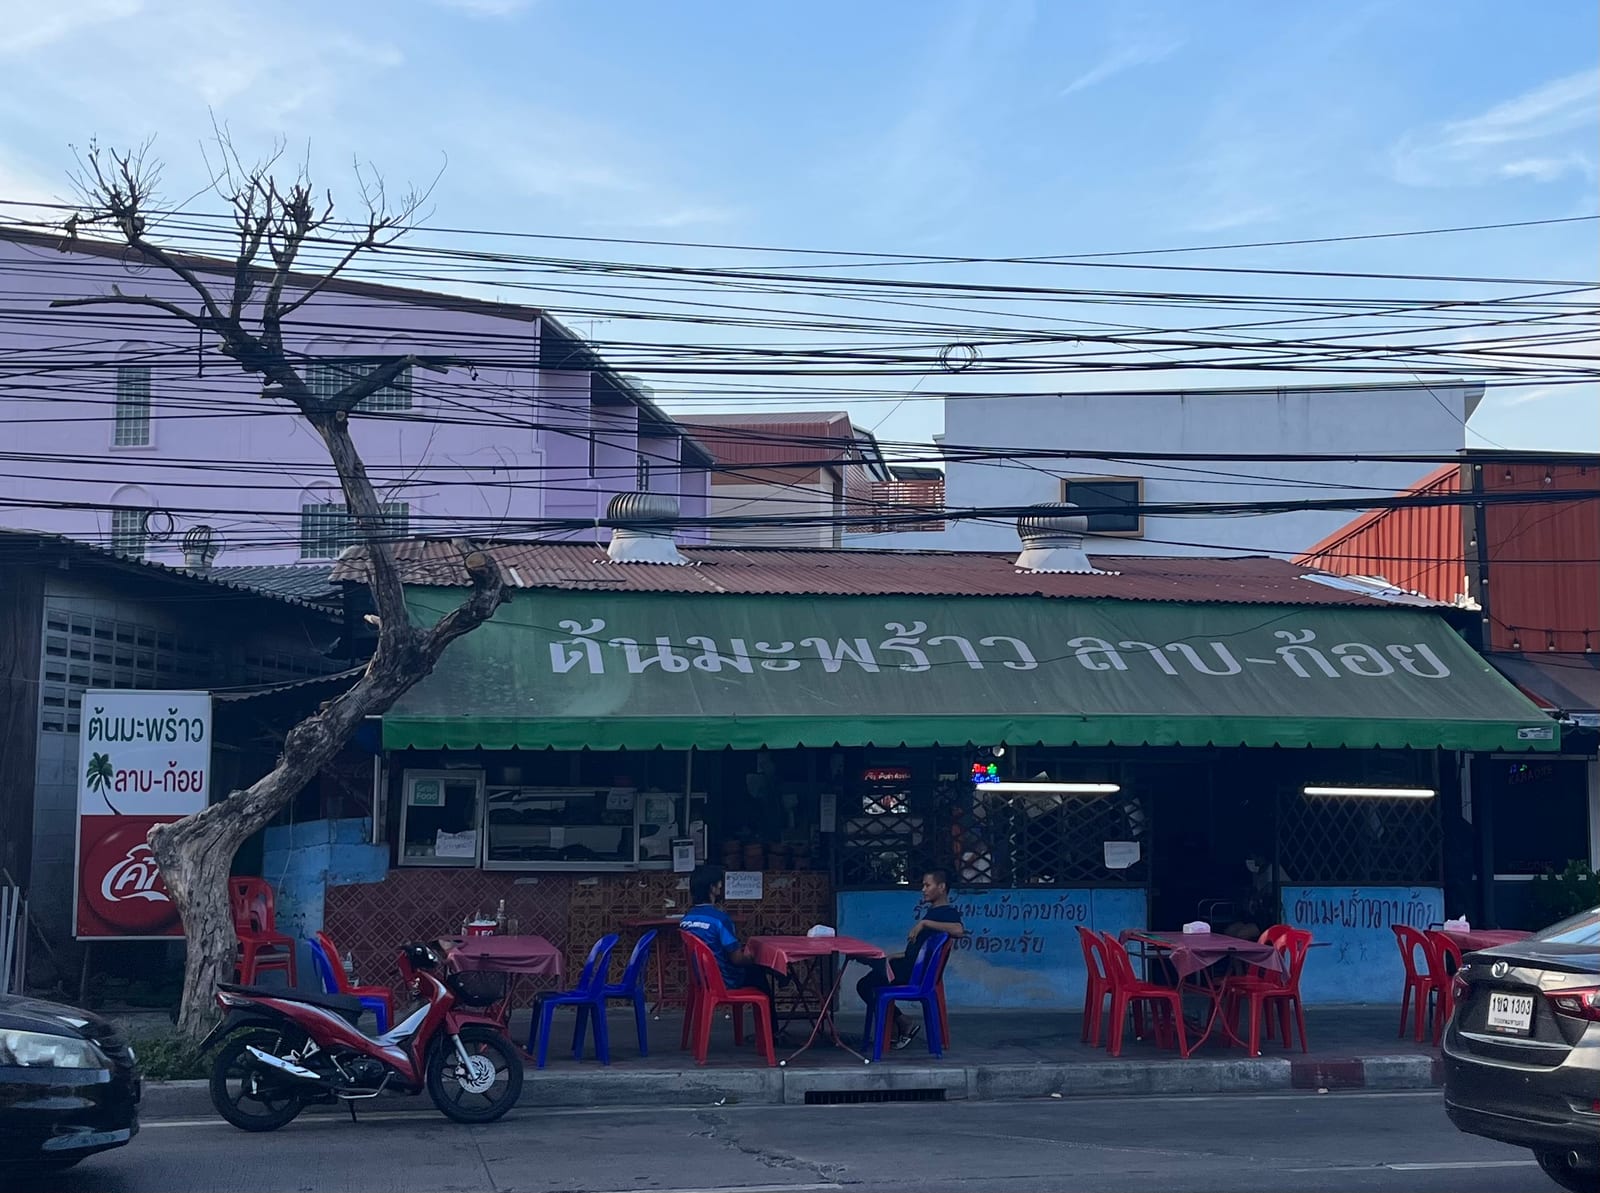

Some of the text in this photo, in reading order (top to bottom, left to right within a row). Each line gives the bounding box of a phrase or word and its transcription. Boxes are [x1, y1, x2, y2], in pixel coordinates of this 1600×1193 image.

[549, 618, 1451, 680] ต้นมะพร้าว ลาบ-ก้อย
[87, 707, 205, 743] ต้นมะพร้าว
[114, 761, 204, 793] ลาบ-ก้อย
[416, 791, 438, 801] Food
[1511, 998, 1531, 1016] 1303
